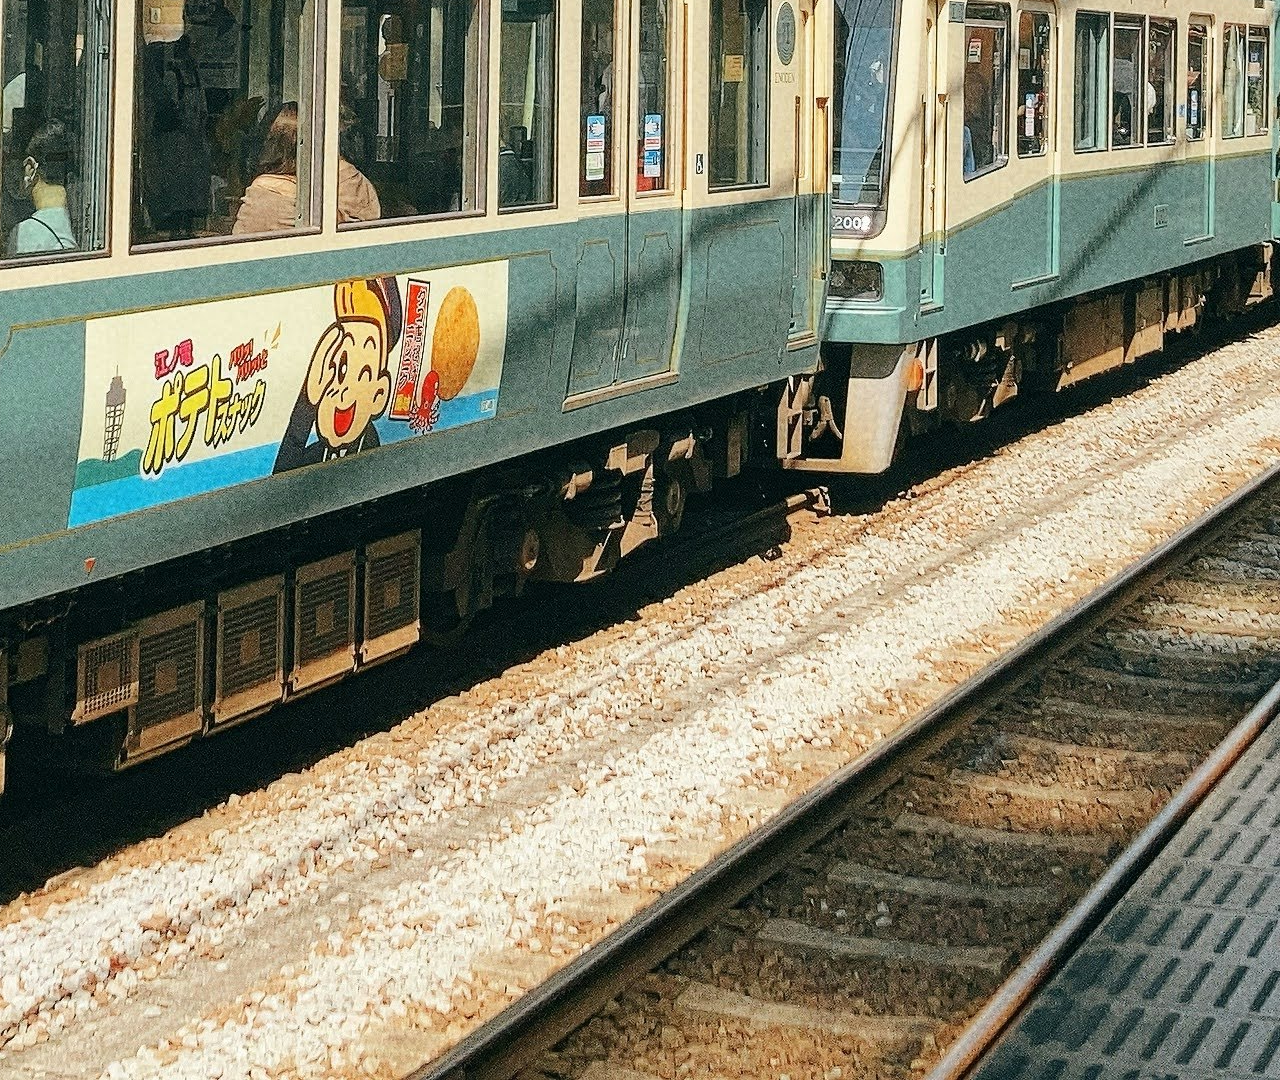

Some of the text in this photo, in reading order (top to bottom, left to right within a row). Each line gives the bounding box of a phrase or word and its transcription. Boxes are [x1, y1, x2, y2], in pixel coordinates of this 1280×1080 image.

[154, 339, 194, 380] 江ノ電
[142, 354, 233, 476] ポテト
[213, 378, 267, 449] スナック
